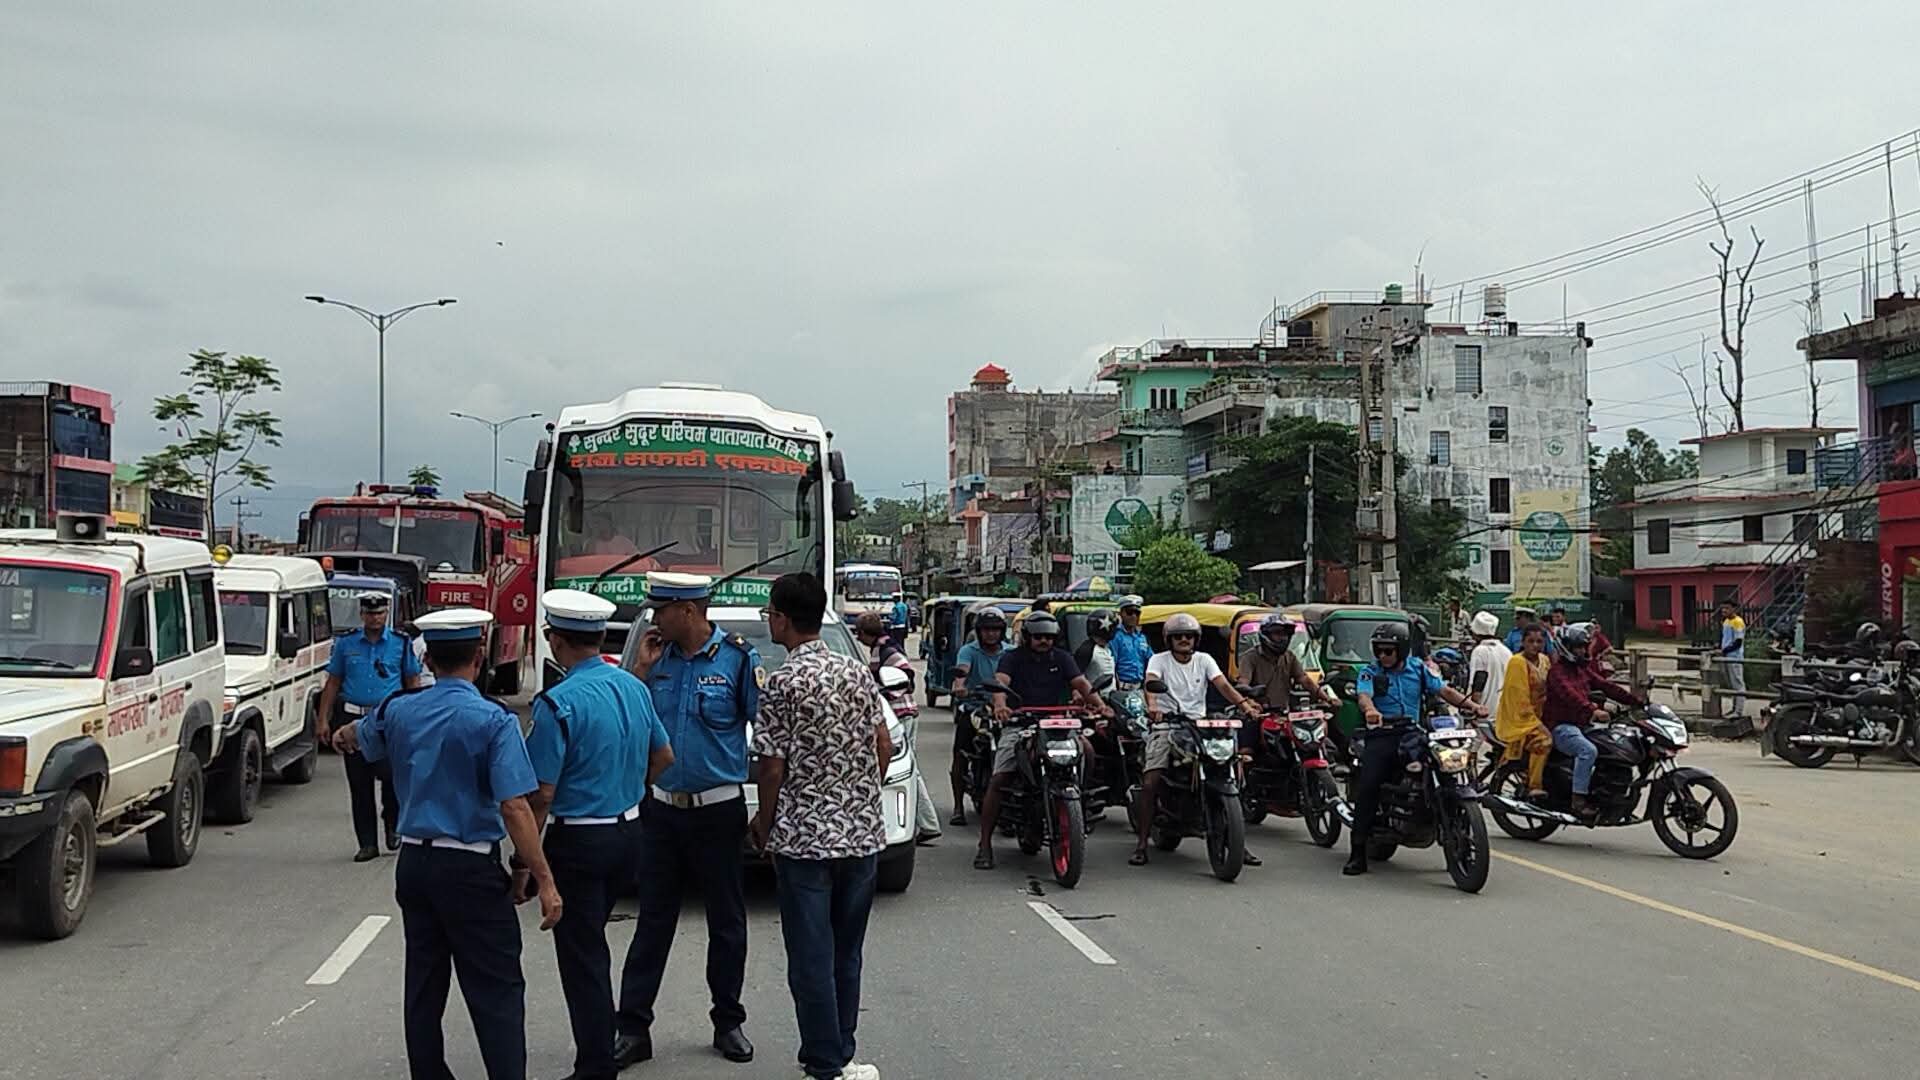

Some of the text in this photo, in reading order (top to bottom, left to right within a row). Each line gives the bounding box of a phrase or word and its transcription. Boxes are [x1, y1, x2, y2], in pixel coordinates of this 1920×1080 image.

[583, 426, 621, 453] सुन्दर
[624, 423, 659, 446] सुदूर
[709, 426, 768, 449] यातायात
[623, 448, 708, 468] सफारी
[440, 591, 471, 603] FIRE
[1881, 562, 1893, 621] SERVO
